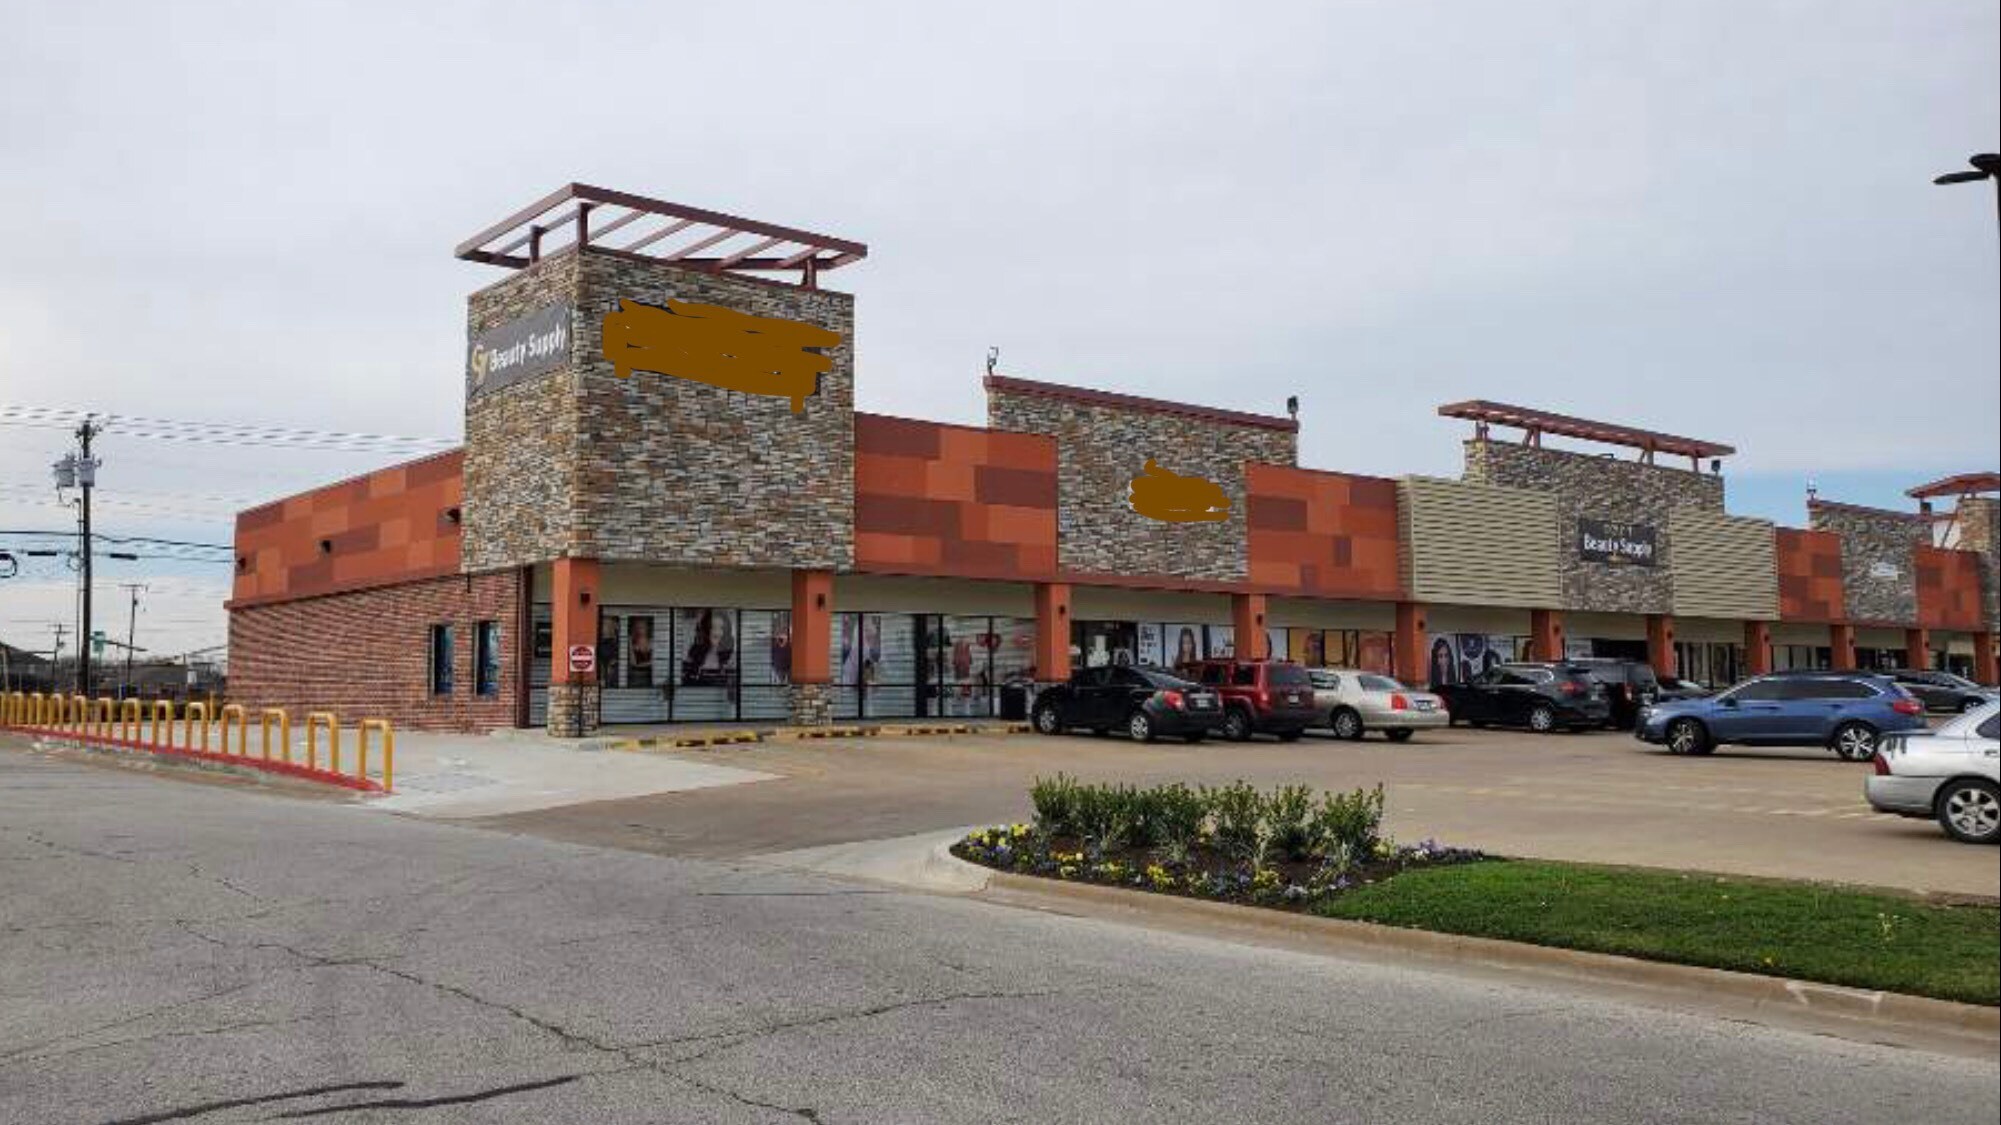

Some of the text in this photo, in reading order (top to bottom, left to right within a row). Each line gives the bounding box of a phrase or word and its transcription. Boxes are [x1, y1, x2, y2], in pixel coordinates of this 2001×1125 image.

[489, 340, 526, 373] Beauty
[528, 322, 566, 357] Supply
[1583, 532, 1653, 558] Beauty Supply
